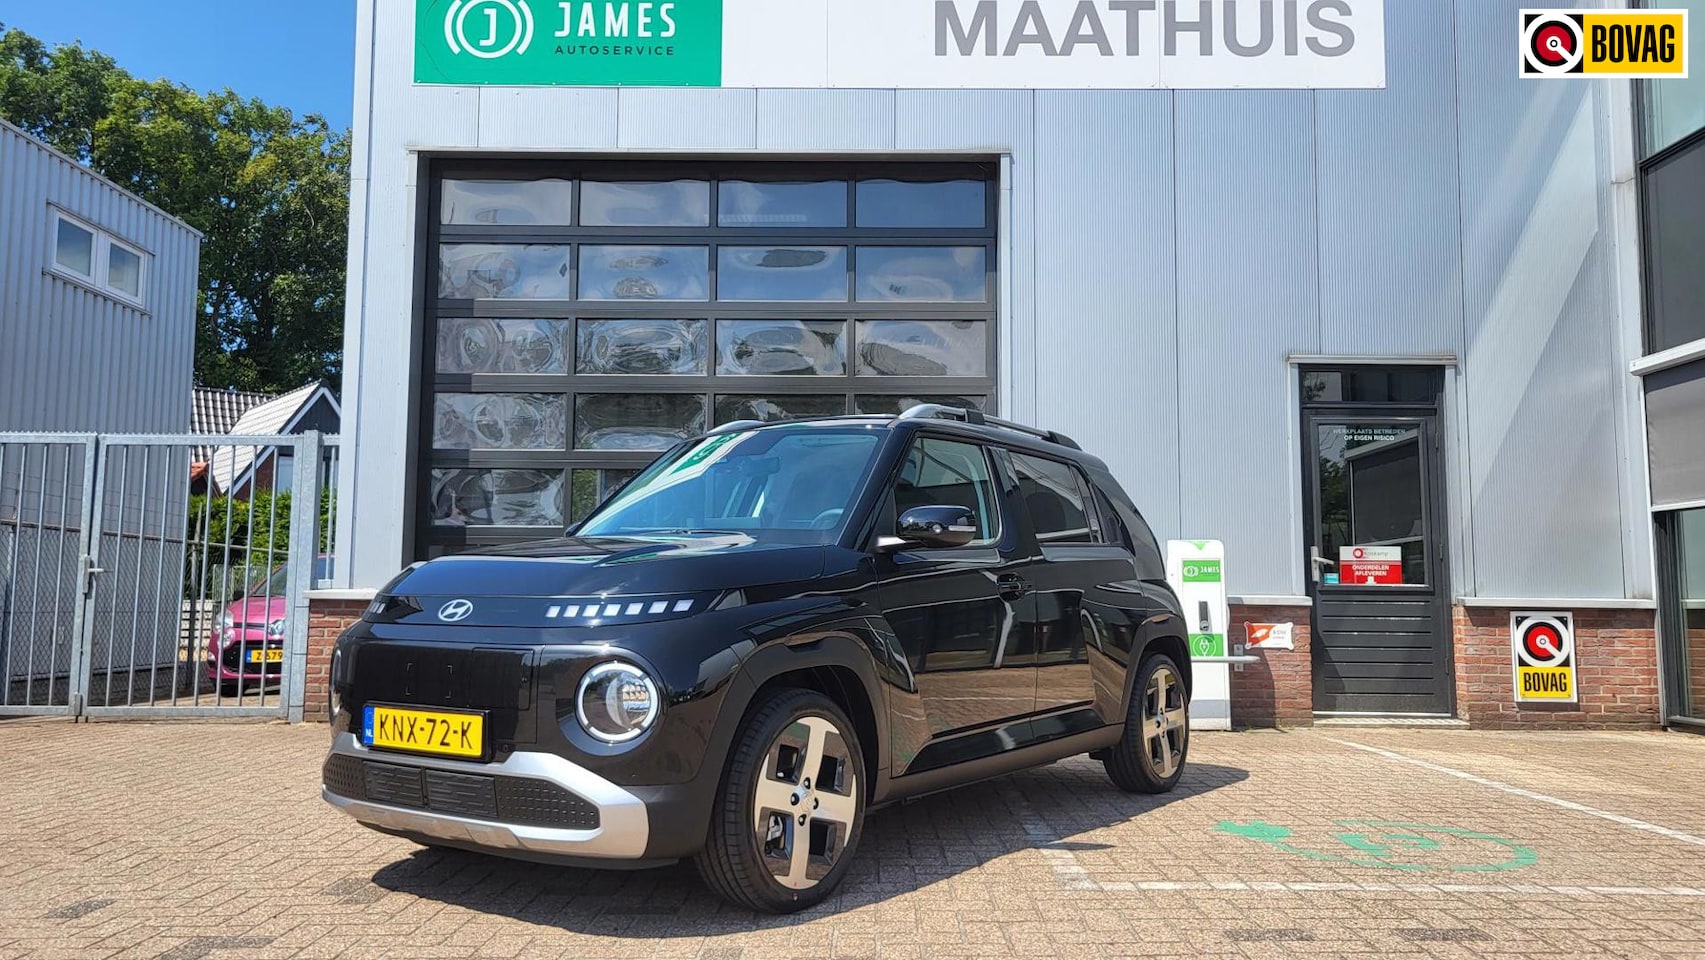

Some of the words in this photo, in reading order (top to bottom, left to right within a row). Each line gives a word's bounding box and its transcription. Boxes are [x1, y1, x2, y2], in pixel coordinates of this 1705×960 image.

[554, 2, 676, 38] JAMES
[934, 0, 1356, 57] MAATHUIS
[554, 45, 675, 56] AUTOSERVICE
[1200, 565, 1220, 573] JAMES
[1523, 672, 1567, 692] BOVAG
[365, 728, 374, 738] NL
[380, 713, 473, 749] KNX-72-K
